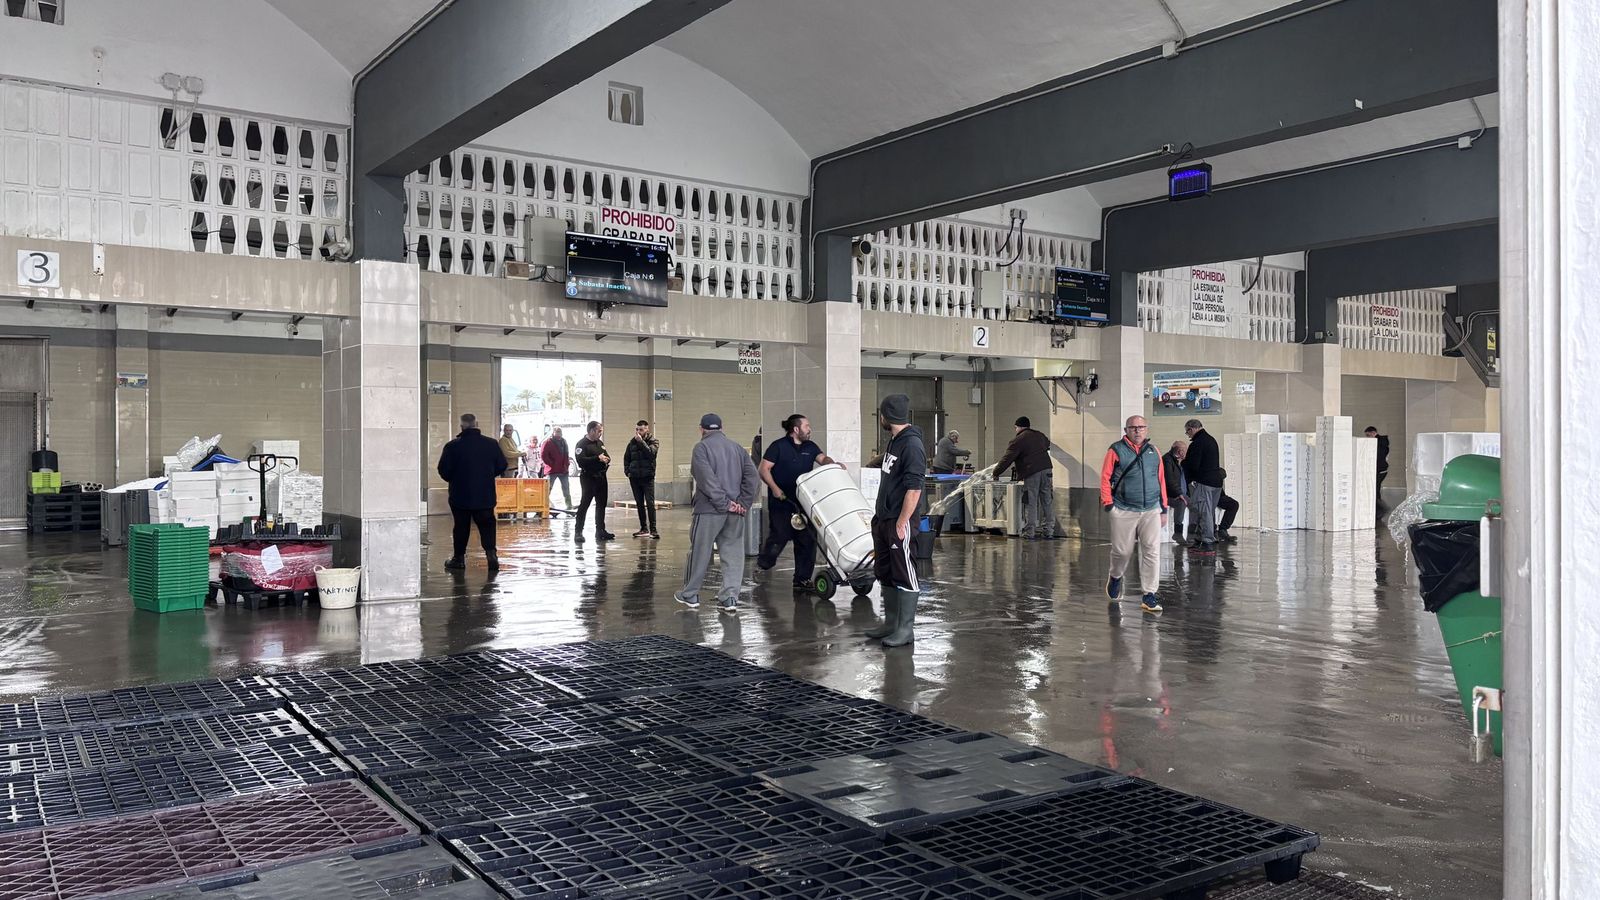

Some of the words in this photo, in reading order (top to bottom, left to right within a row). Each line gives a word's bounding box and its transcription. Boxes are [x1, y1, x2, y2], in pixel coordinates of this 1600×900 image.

[602, 207, 675, 232] PROHIBIDO
[28, 252, 51, 284] 3
[624, 271, 640, 280] Caja
[1192, 269, 1225, 282] PROHIBIDA
[578, 280, 604, 288] Subasta
[606, 283, 632, 291] Inactiva
[1193, 283, 1199, 291] LA
[1201, 283, 1220, 293] ESTANCIA
[1221, 286, 1225, 294] A
[1195, 293, 1201, 301] LA
[1202, 294, 1216, 303] LONJA
[1217, 295, 1223, 304] DE
[1192, 302, 1204, 311] TODA
[1205, 304, 1225, 313] PERSONA
[1373, 305, 1399, 317] PROHIBIDO
[1374, 317, 1392, 327] GRABAR
[1393, 319, 1399, 328] EN
[977, 327, 986, 346] 2
[1374, 328, 1380, 336] LA
[1382, 328, 1399, 338] LONJA
